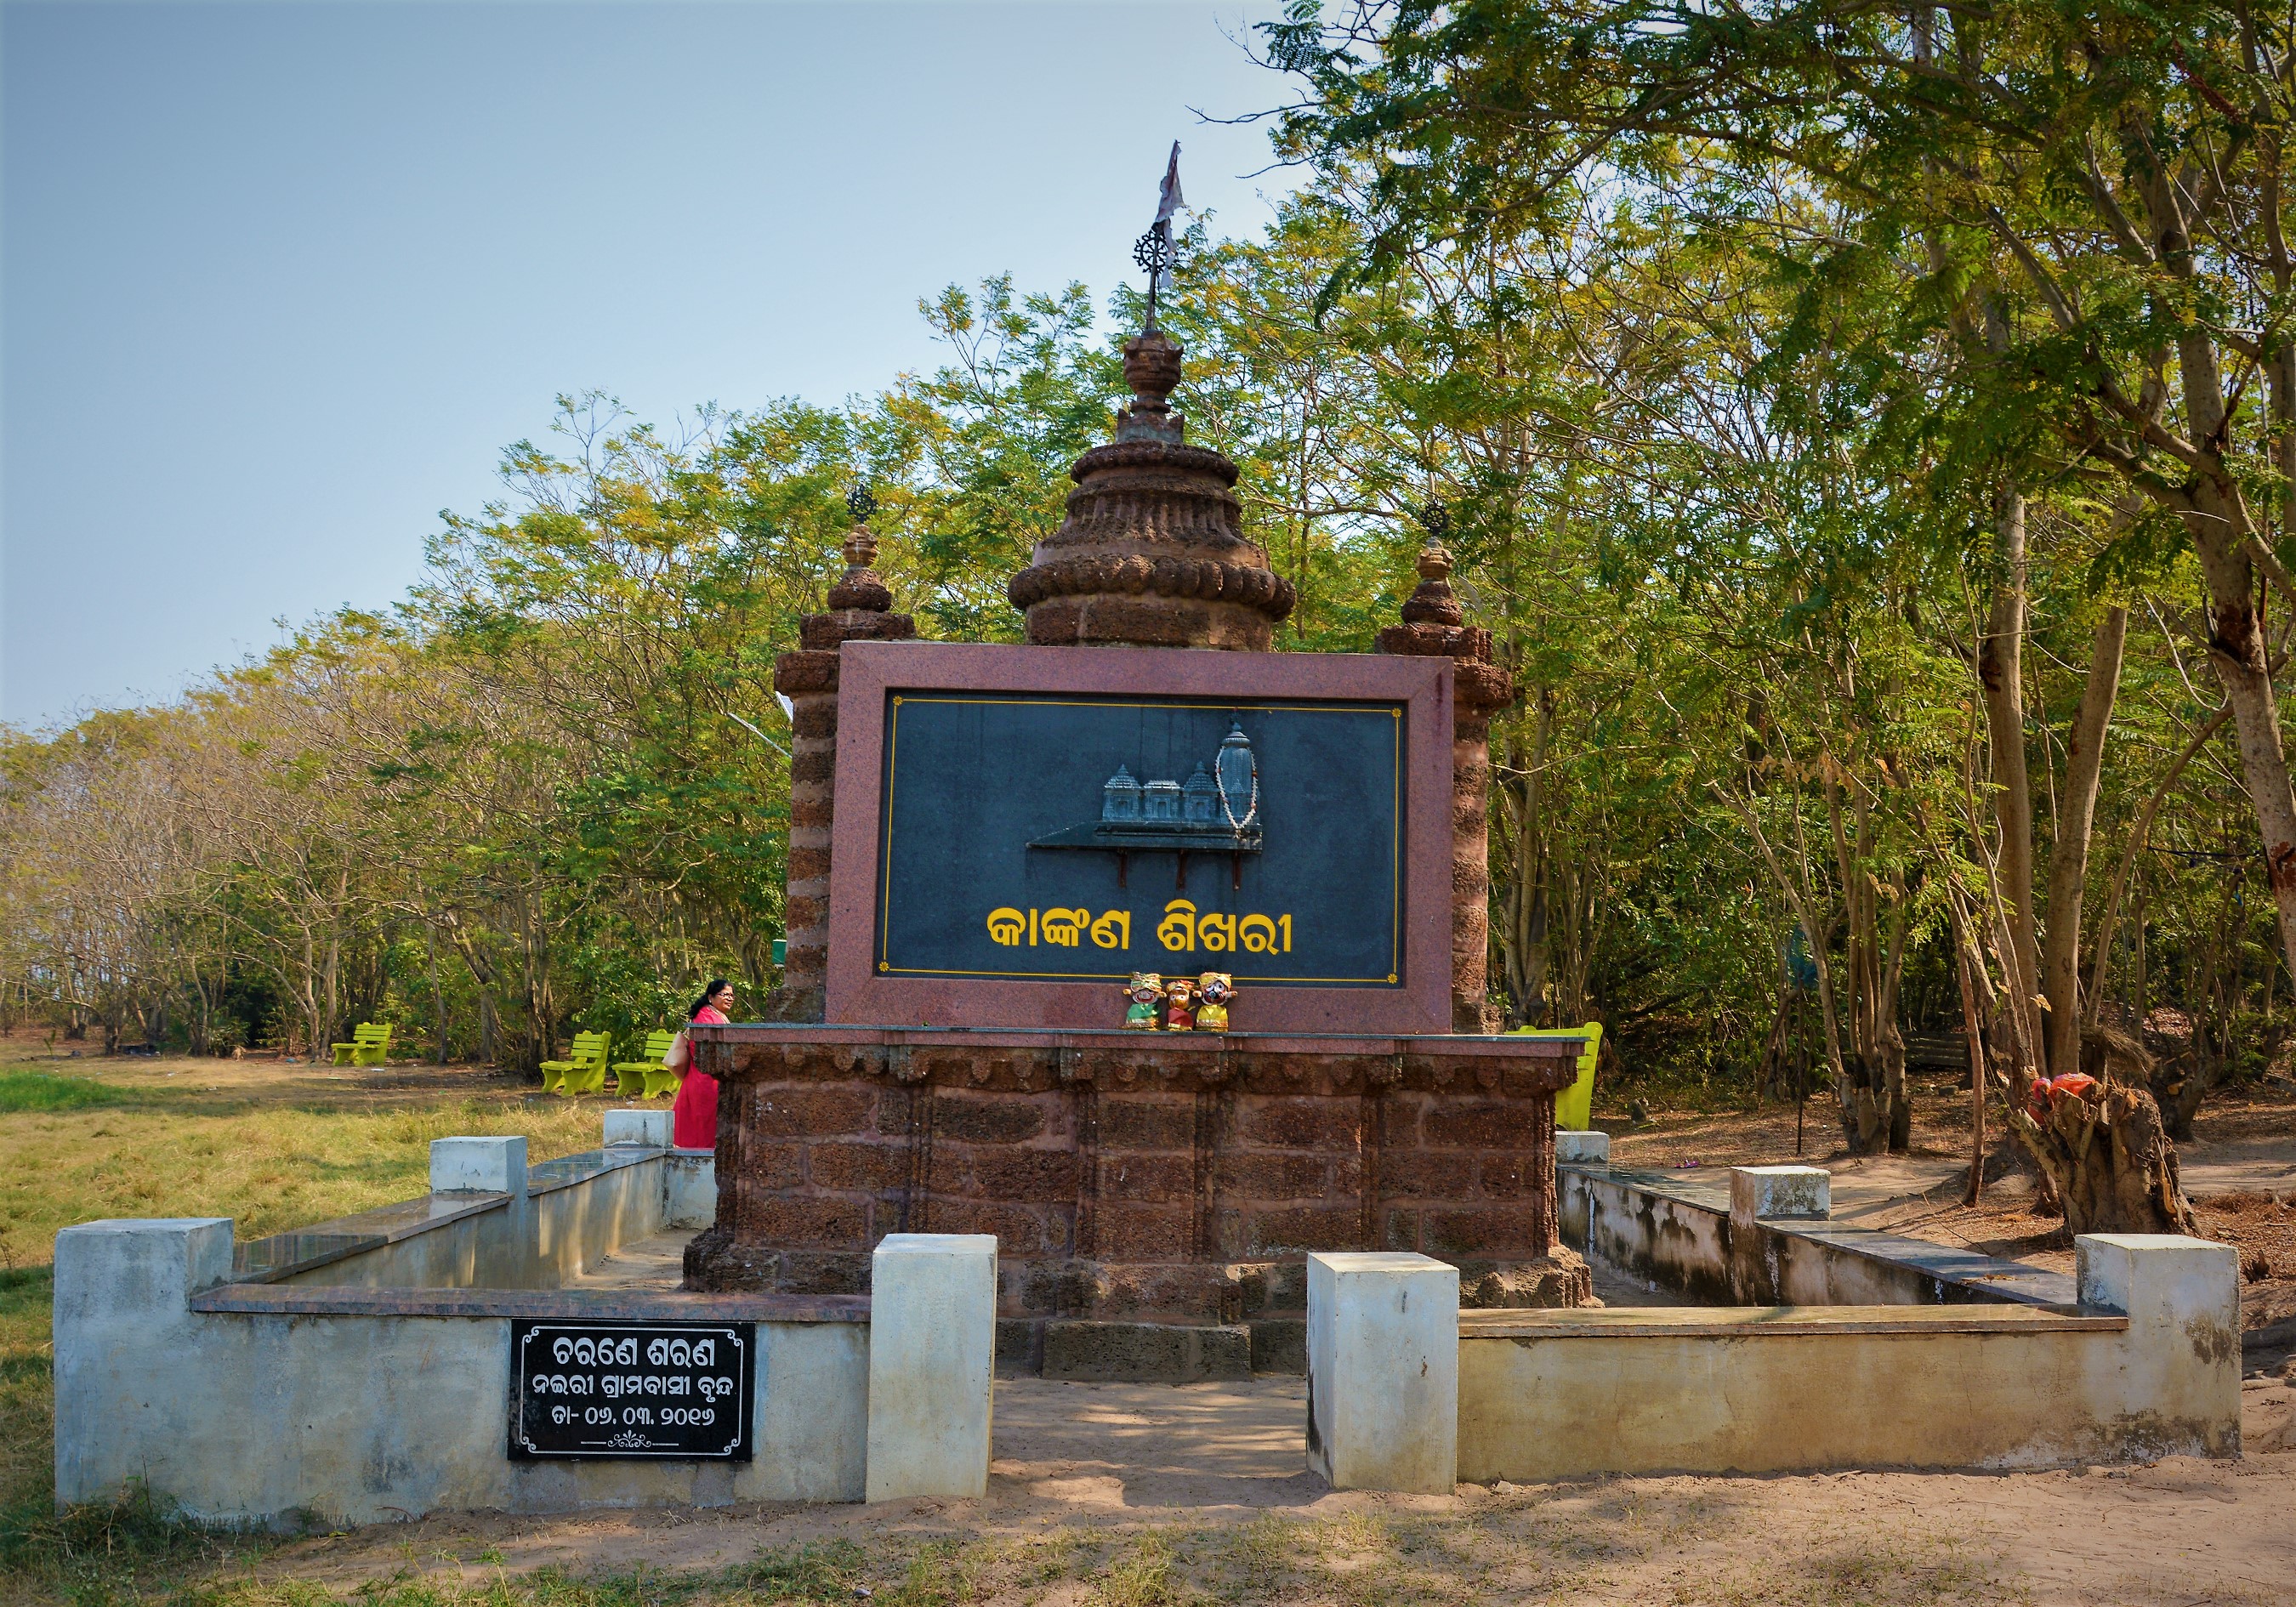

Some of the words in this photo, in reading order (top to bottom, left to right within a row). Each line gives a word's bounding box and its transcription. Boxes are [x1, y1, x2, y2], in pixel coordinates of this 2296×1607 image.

[986, 906, 1131, 950] କାଙ୍କଣ
[1157, 899, 1292, 956] ଶିଖରୀ
[553, 1337, 638, 1367] ଚରଣେ
[646, 1338, 715, 1368] ଶରଣ
[532, 1374, 594, 1395] ନଇରୀ
[600, 1375, 691, 1399] ଗ୍ରାମବାସୀ
